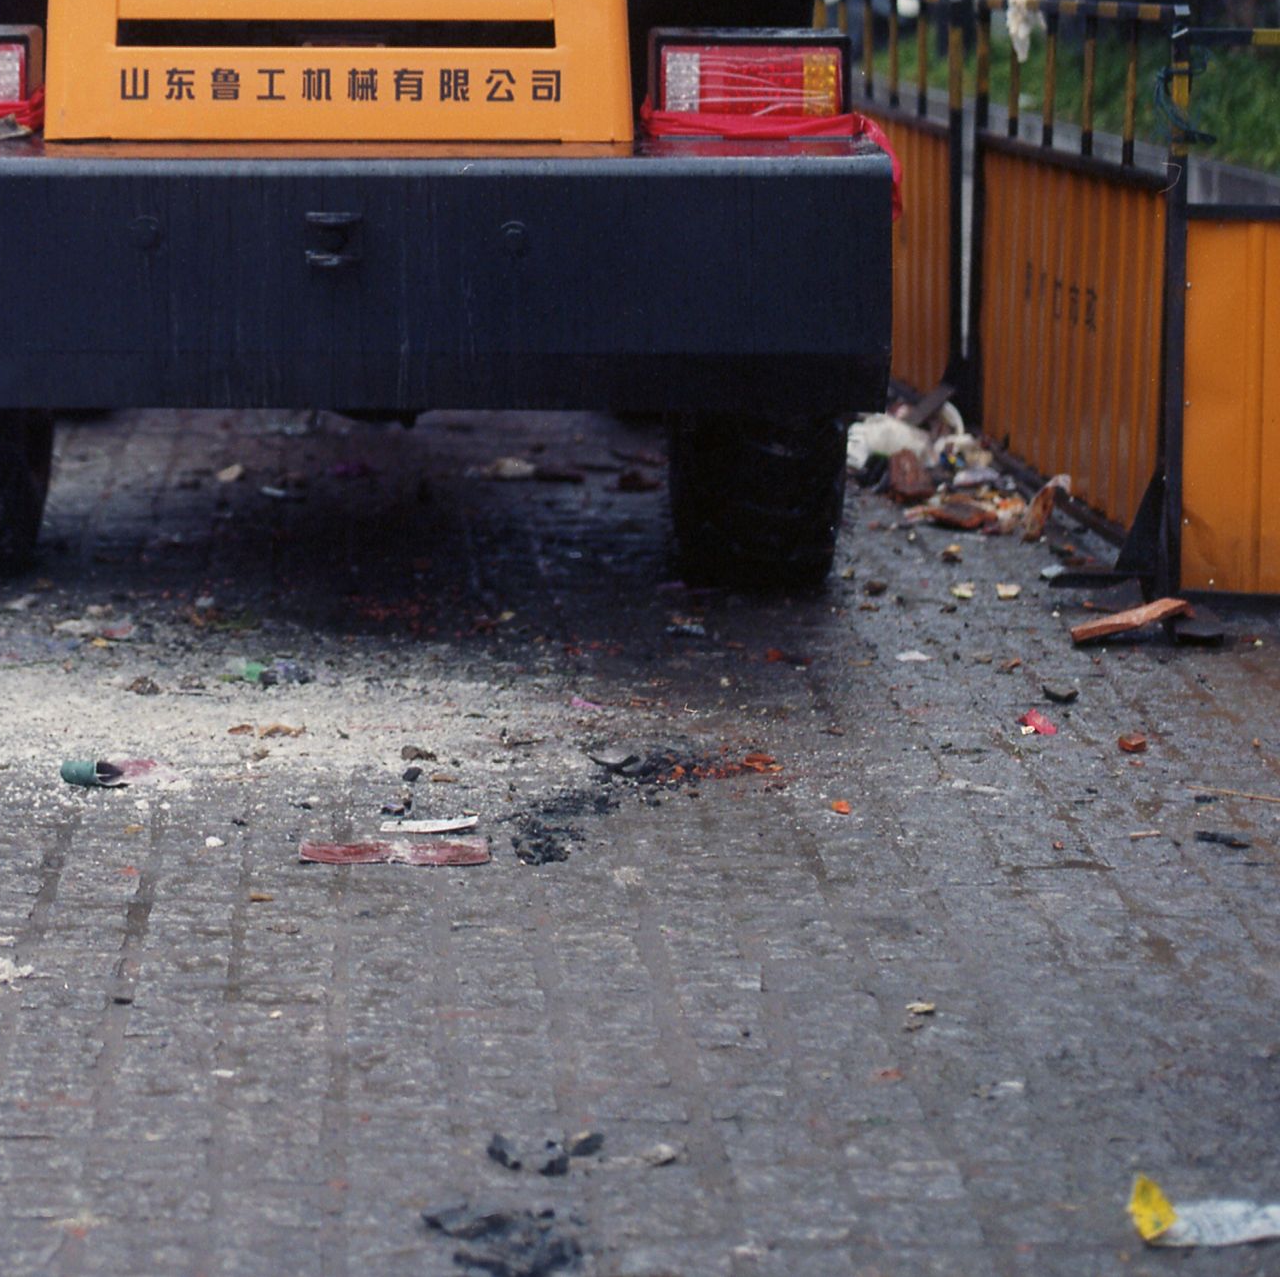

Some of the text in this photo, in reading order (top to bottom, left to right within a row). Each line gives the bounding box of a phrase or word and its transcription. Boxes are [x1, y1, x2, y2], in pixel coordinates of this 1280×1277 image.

[119, 67, 562, 102] 山东鲁工机械有限公司
